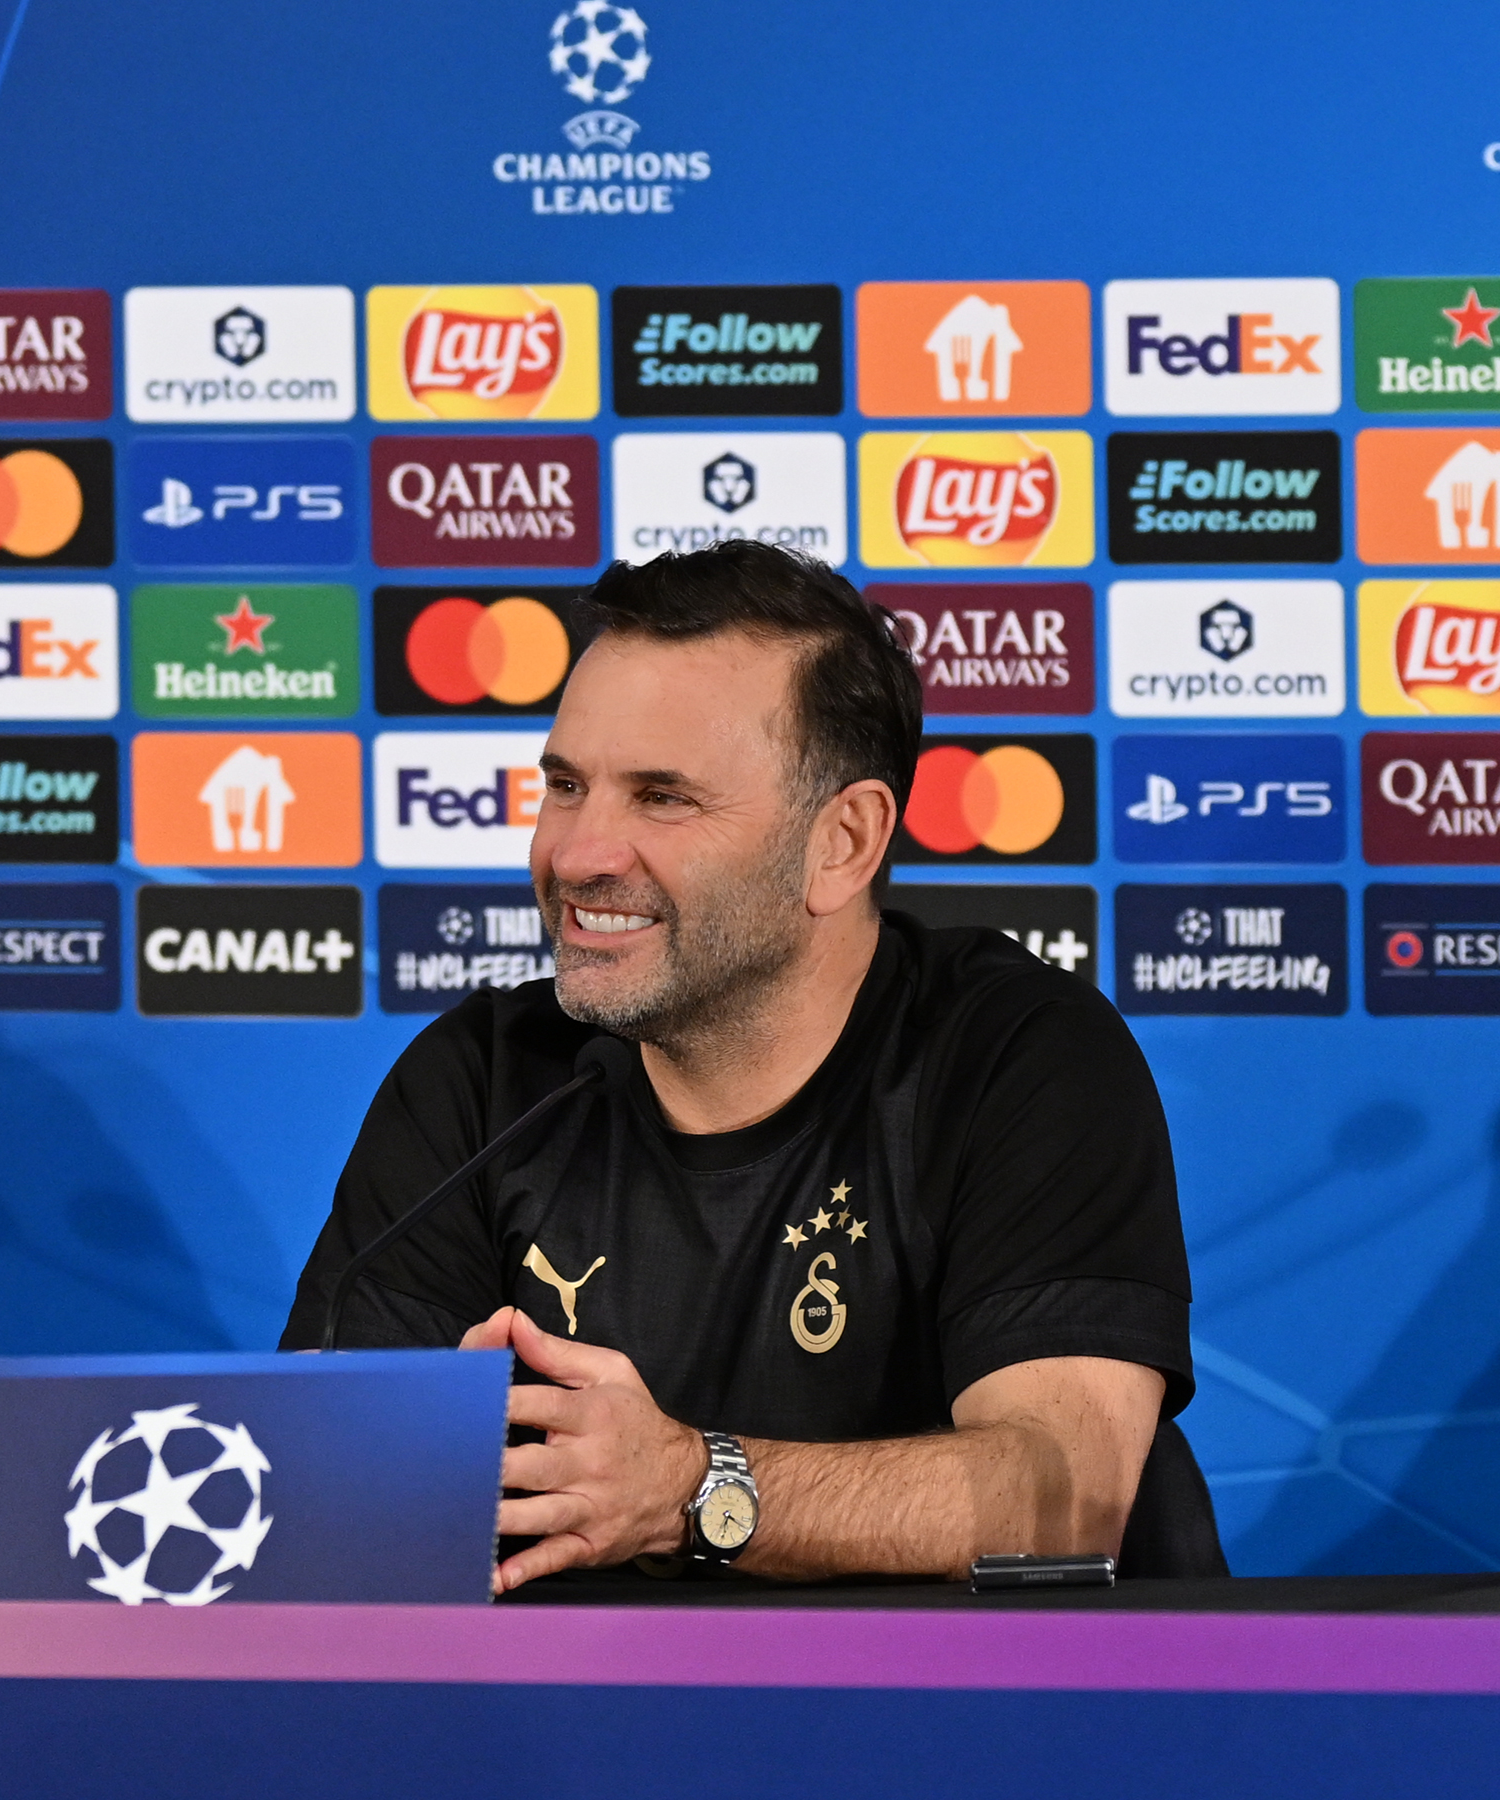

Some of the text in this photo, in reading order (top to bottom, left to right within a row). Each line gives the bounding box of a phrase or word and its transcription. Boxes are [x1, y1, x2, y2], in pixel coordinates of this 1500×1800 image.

[493, 152, 711, 182] CHAMPIONS
[533, 185, 673, 214] LEAGUE
[662, 315, 821, 353] Follow
[1127, 314, 1322, 376] FedEx
[412, 310, 552, 398] Lay's
[639, 357, 818, 386] Scores.com
[144, 376, 337, 405] crypto.com
[388, 461, 571, 517] QATAR
[1156, 460, 1319, 500] Follow
[213, 486, 343, 520] PS5
[906, 452, 1050, 546] Lay's
[435, 511, 574, 540] AIRWAYS
[1135, 504, 1316, 532] Scores.com
[1405, 607, 1500, 694] Lay
[155, 663, 336, 699] Heineken
[929, 659, 1070, 687] AIRWAYS
[1129, 670, 1326, 701] crypto.com
[397, 768, 541, 828] FedE
[1199, 782, 1331, 816] PS5
[1380, 760, 1500, 815] QAT
[1224, 908, 1284, 946] THAT
[145, 928, 354, 972] CANAL+
[808, 1306, 827, 1317] 1905
